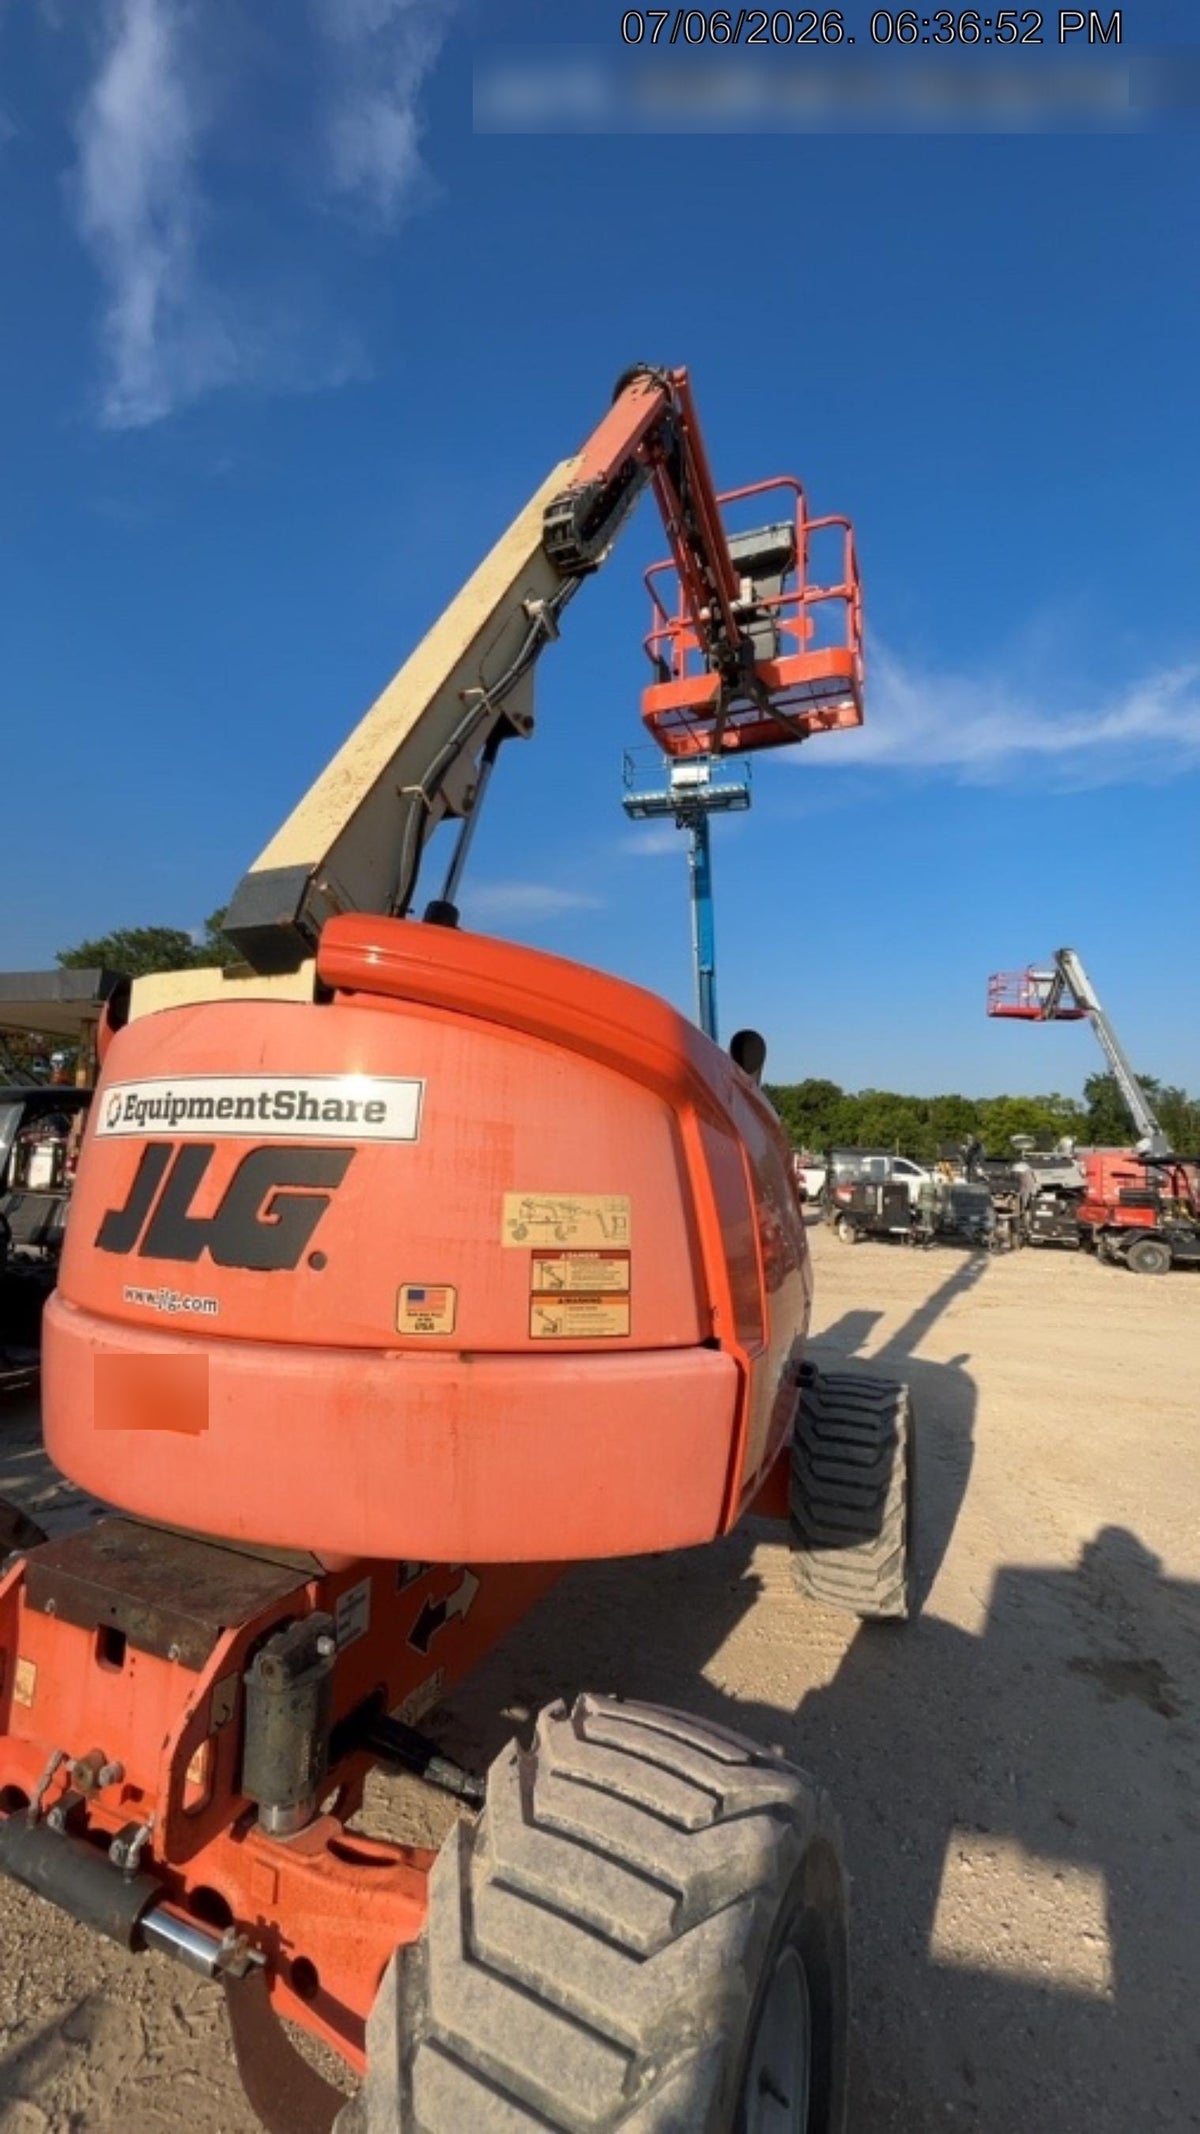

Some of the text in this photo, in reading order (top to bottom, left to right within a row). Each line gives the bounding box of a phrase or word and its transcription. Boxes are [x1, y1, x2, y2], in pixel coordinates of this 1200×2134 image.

[122, 1089, 387, 1128] EquipmentShare
[94, 1142, 358, 1271] JLG
[124, 1287, 218, 1313] www.jlg.com
